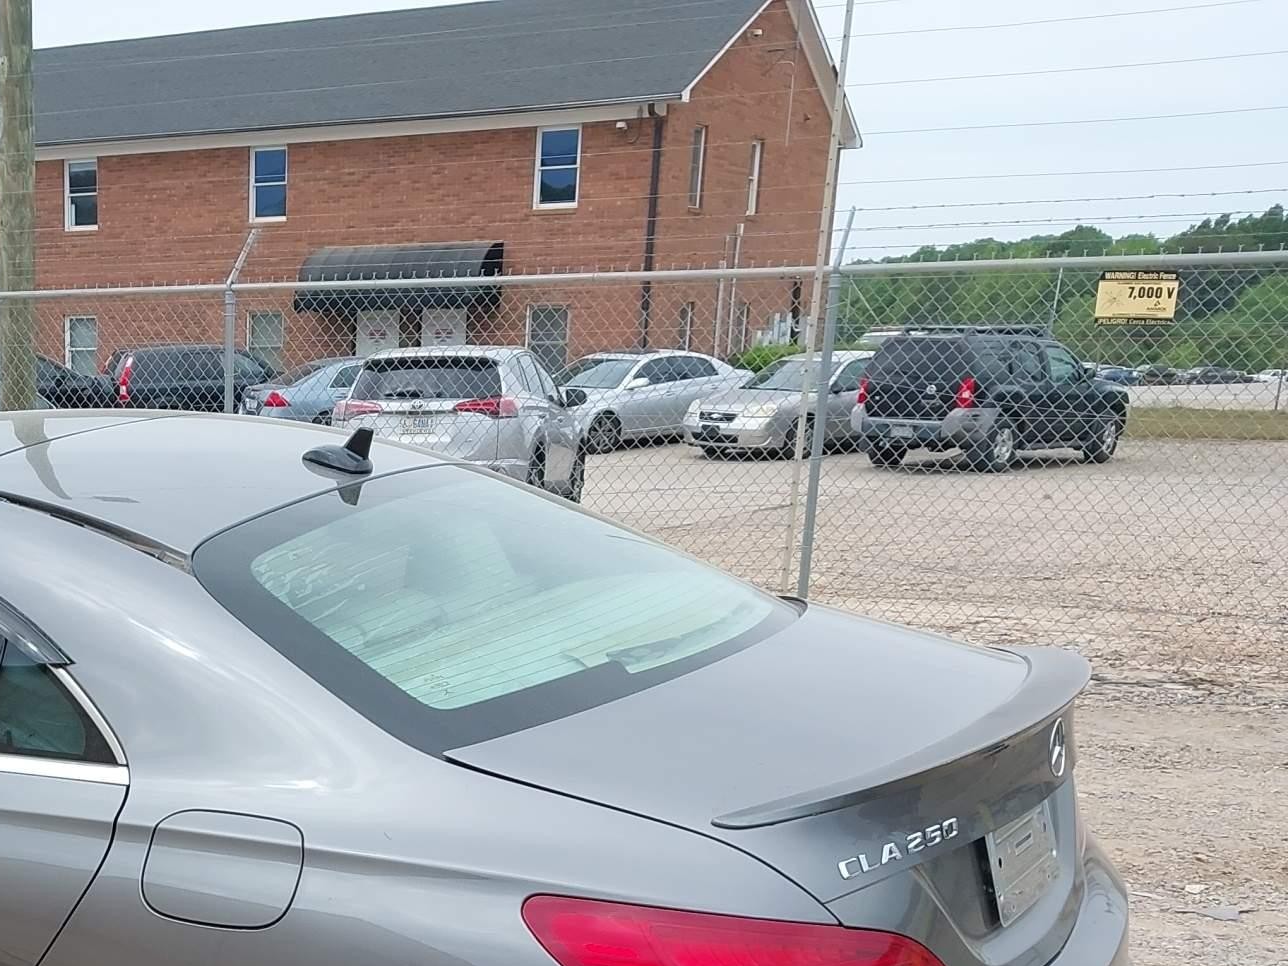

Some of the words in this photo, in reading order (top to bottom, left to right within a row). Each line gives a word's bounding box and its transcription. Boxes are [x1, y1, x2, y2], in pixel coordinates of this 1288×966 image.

[1105, 272, 1137, 280] WARNING!
[1138, 272, 1159, 280] Electric
[1159, 272, 1177, 280] Fence
[1128, 286, 1163, 300] 7,000
[1167, 287, 1175, 299] V
[837, 842, 903, 880] CLA
[906, 817, 959, 854] 250
